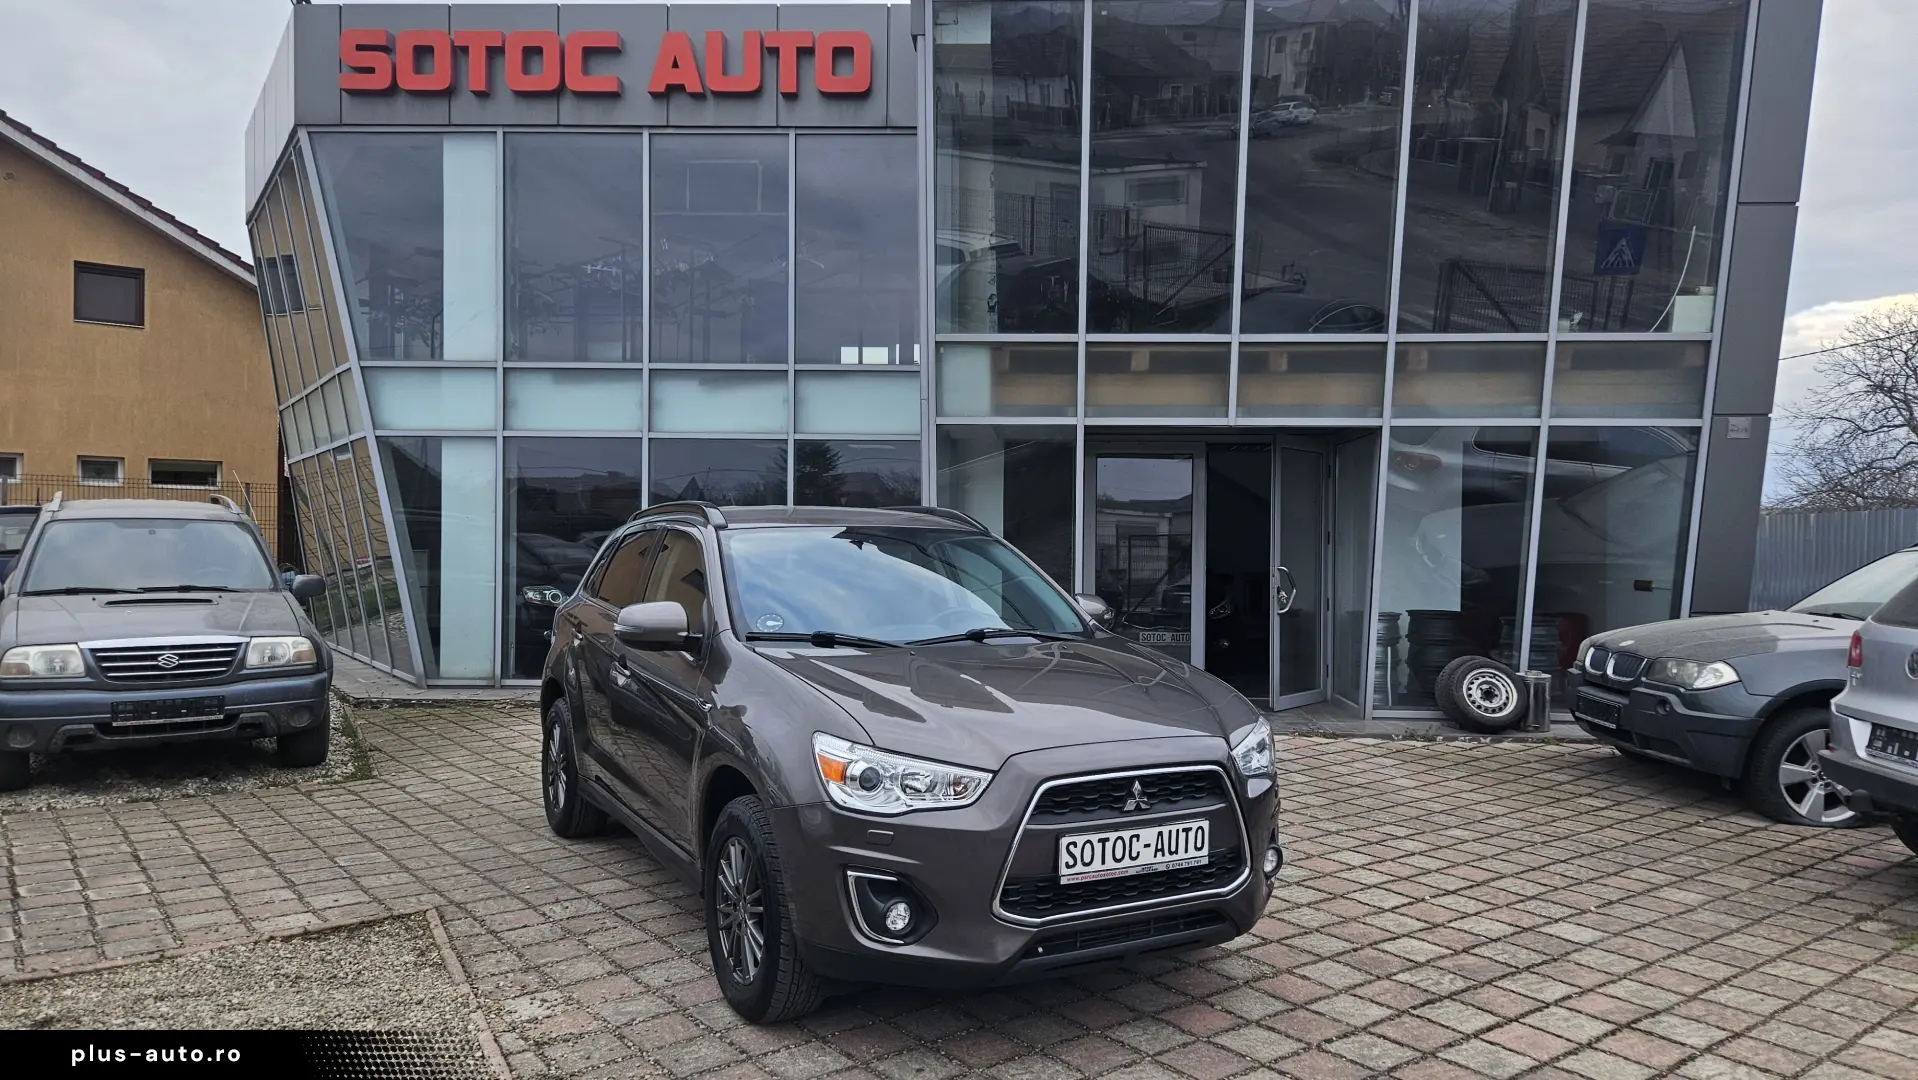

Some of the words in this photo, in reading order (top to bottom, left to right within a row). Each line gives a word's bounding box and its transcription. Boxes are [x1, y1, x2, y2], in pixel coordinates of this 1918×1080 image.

[339, 28, 622, 95] SOTOC
[647, 29, 873, 97] AUTO
[1065, 825, 1205, 869] SOTOC-AUTO
